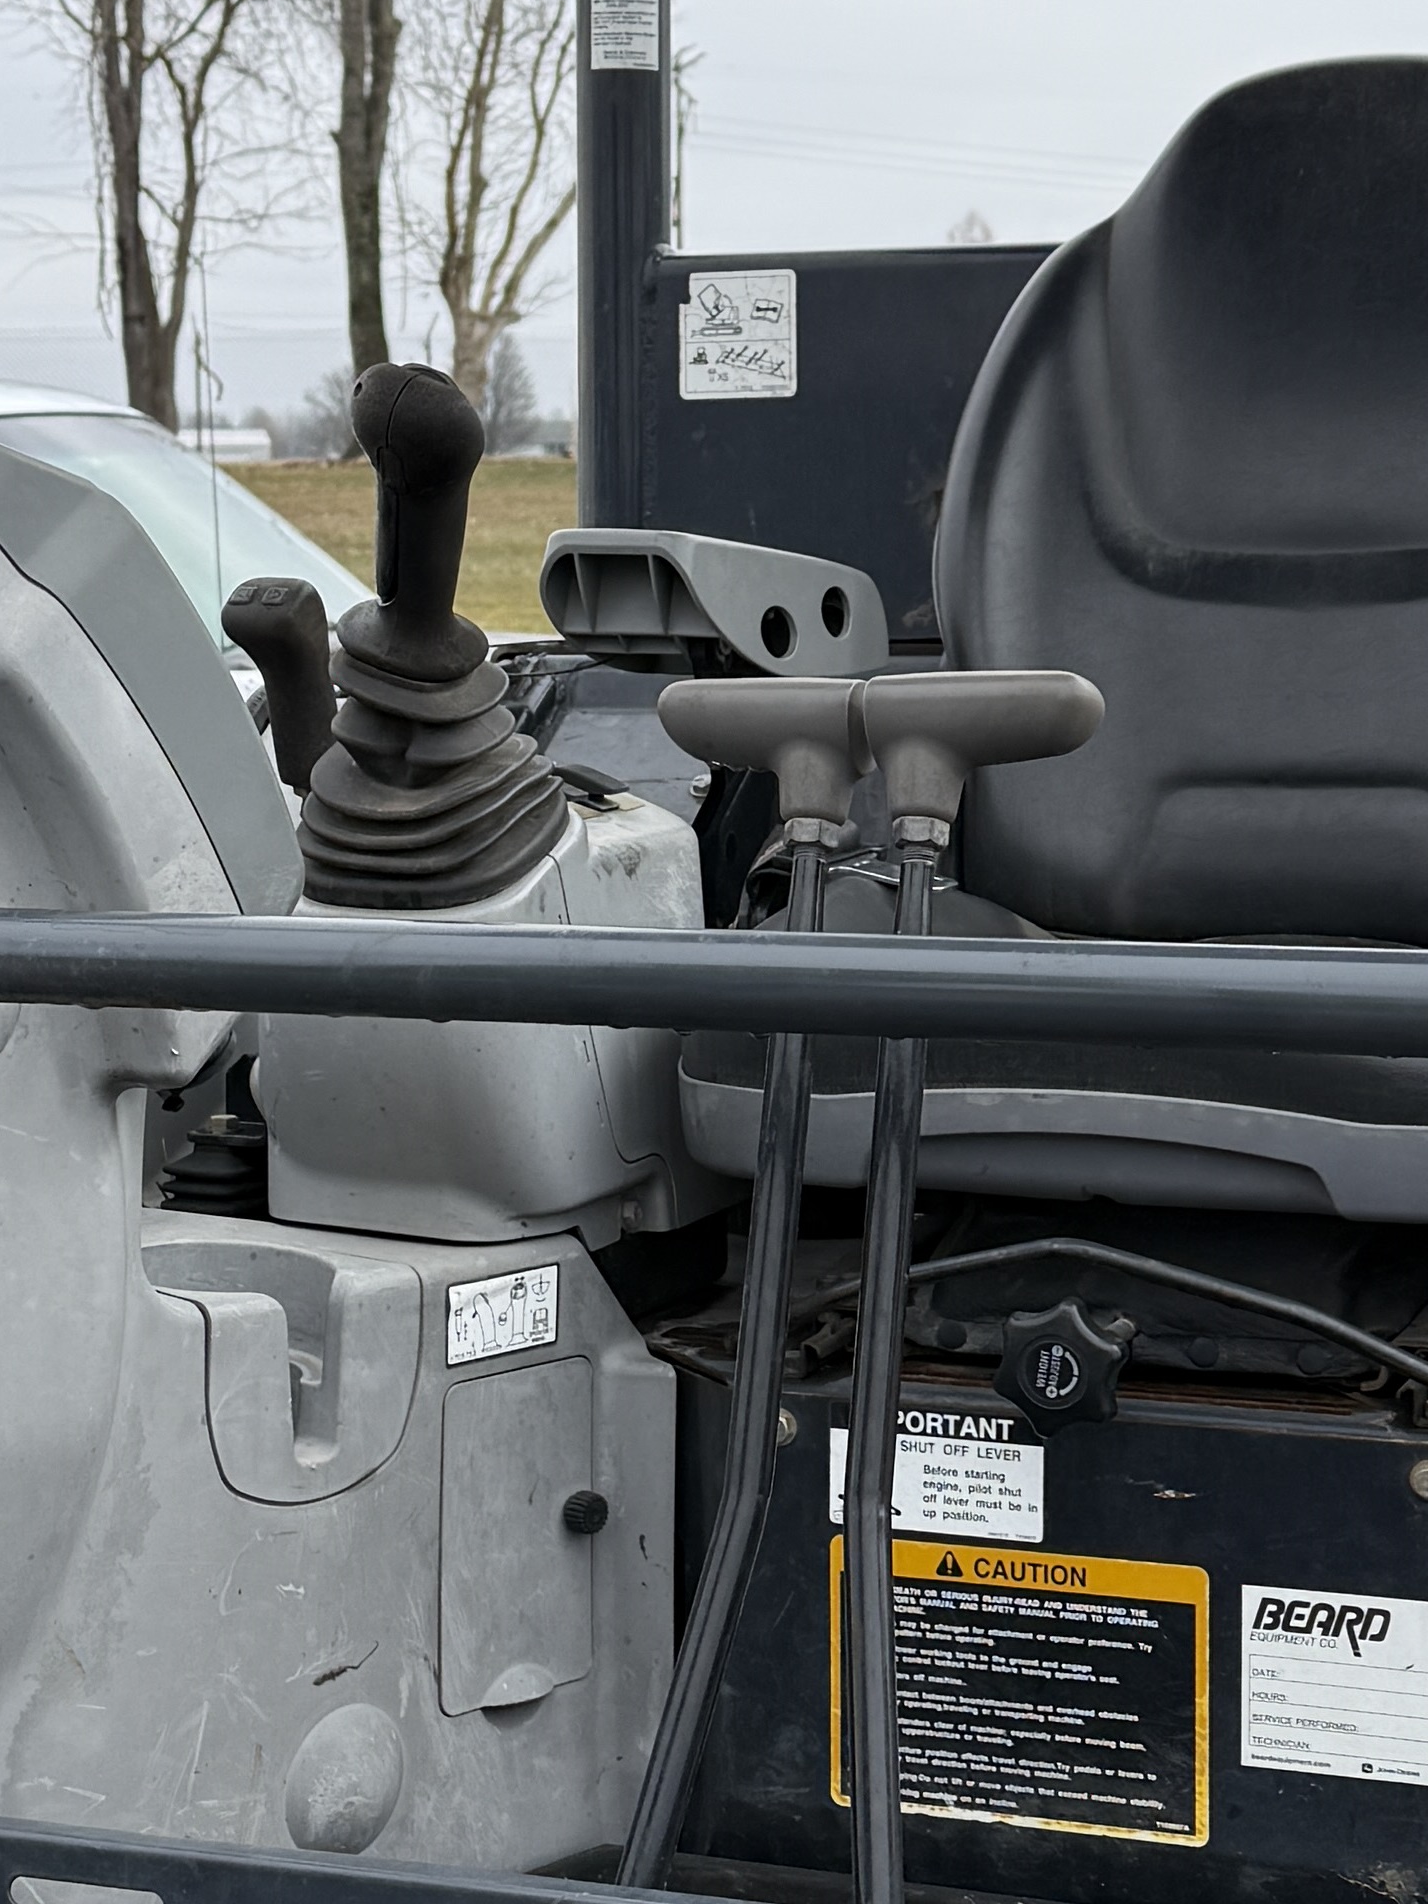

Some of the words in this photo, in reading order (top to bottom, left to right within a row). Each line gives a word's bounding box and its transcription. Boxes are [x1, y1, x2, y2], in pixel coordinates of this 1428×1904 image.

[1036, 1350, 1050, 1388] WEIGHT
[1048, 1355, 1061, 1387] ADJUST
[900, 1438, 935, 1455] SHUT
[943, 1443, 969, 1457] OFF
[977, 1445, 1021, 1462] LEVER
[923, 1464, 957, 1477] Before
[964, 1468, 1005, 1483] starting
[922, 1479, 961, 1493] engine,
[968, 1483, 991, 1496] pilot
[998, 1485, 1021, 1496] shut
[922, 1493, 936, 1503] off
[943, 1495, 968, 1506] lever
[975, 1498, 1001, 1510] must
[1008, 1501, 1021, 1511] be
[1028, 1502, 1038, 1512] in
[922, 1507, 936, 1519] up
[942, 1509, 988, 1524] position.
[973, 1557, 1086, 1587] CAUTION
[919, 1597, 956, 1608] MANUAL
[959, 1601, 977, 1610] AND
[981, 1603, 1014, 1614] SAFETY
[1018, 1607, 1056, 1618] MANUAL
[1059, 1611, 1086, 1621] PRIOR
[1091, 1614, 1103, 1622] TO
[1107, 1615, 1158, 1628] OPERATING
[940, 1590, 978, 1601] SERIOUS
[1043, 1600, 1062, 1609] AND
[1066, 1602, 1126, 1615] UNDERSTAND
[1130, 1608, 1148, 1617] THE
[899, 1620, 916, 1629] may
[920, 1621, 930, 1629] be
[934, 1623, 969, 1635] changed
[972, 1626, 984, 1634] for
[1049, 1634, 1084, 1646] operator
[1138, 1642, 1152, 1653] Try
[925, 1631, 951, 1640] before
[1252, 1596, 1391, 1659] BEARD
[1250, 1631, 1316, 1646] EQUIPMENT
[1319, 1637, 1338, 1649] CO.
[920, 1647, 952, 1659] working
[955, 1651, 976, 1660] tools
[991, 1655, 1005, 1663] the
[1008, 1656, 1038, 1668] ground
[1042, 1660, 1058, 1669] and
[1061, 1662, 1092, 1674] engage
[968, 1661, 987, 1671] lever
[991, 1664, 1017, 1674] before
[1021, 1667, 1051, 1679] leaving
[1054, 1670, 1096, 1683] operator's
[1252, 1667, 1279, 1677] DATE:
[922, 1692, 956, 1702] between
[1037, 1704, 1052, 1712] and
[1056, 1706, 1094, 1717] overhead
[1251, 1713, 1291, 1724] SERVICE
[934, 1720, 954, 1729] clear
[957, 1723, 966, 1731] of
[1055, 1733, 1081, 1743] before
[1085, 1737, 1116, 1748] moving
[925, 1748, 957, 1760] position
[991, 1755, 1014, 1765] travel
[1073, 1764, 1101, 1776] pedals
[1117, 1769, 1143, 1779] levers
[1147, 1773, 1156, 1781] to
[931, 1758, 966, 1769] direction
[970, 1762, 996, 1772] before
[1000, 1765, 1030, 1777] moving
[1251, 1752, 1330, 1768] beardequipment.com
[934, 1776, 947, 1784] not
[978, 1781, 1001, 1790] move
[1004, 1783, 1034, 1795] objects
[1038, 1787, 1054, 1796] that
[1058, 1789, 1087, 1800] exceed
[1091, 1793, 1126, 1804] machine
[960, 1795, 971, 1803] on
